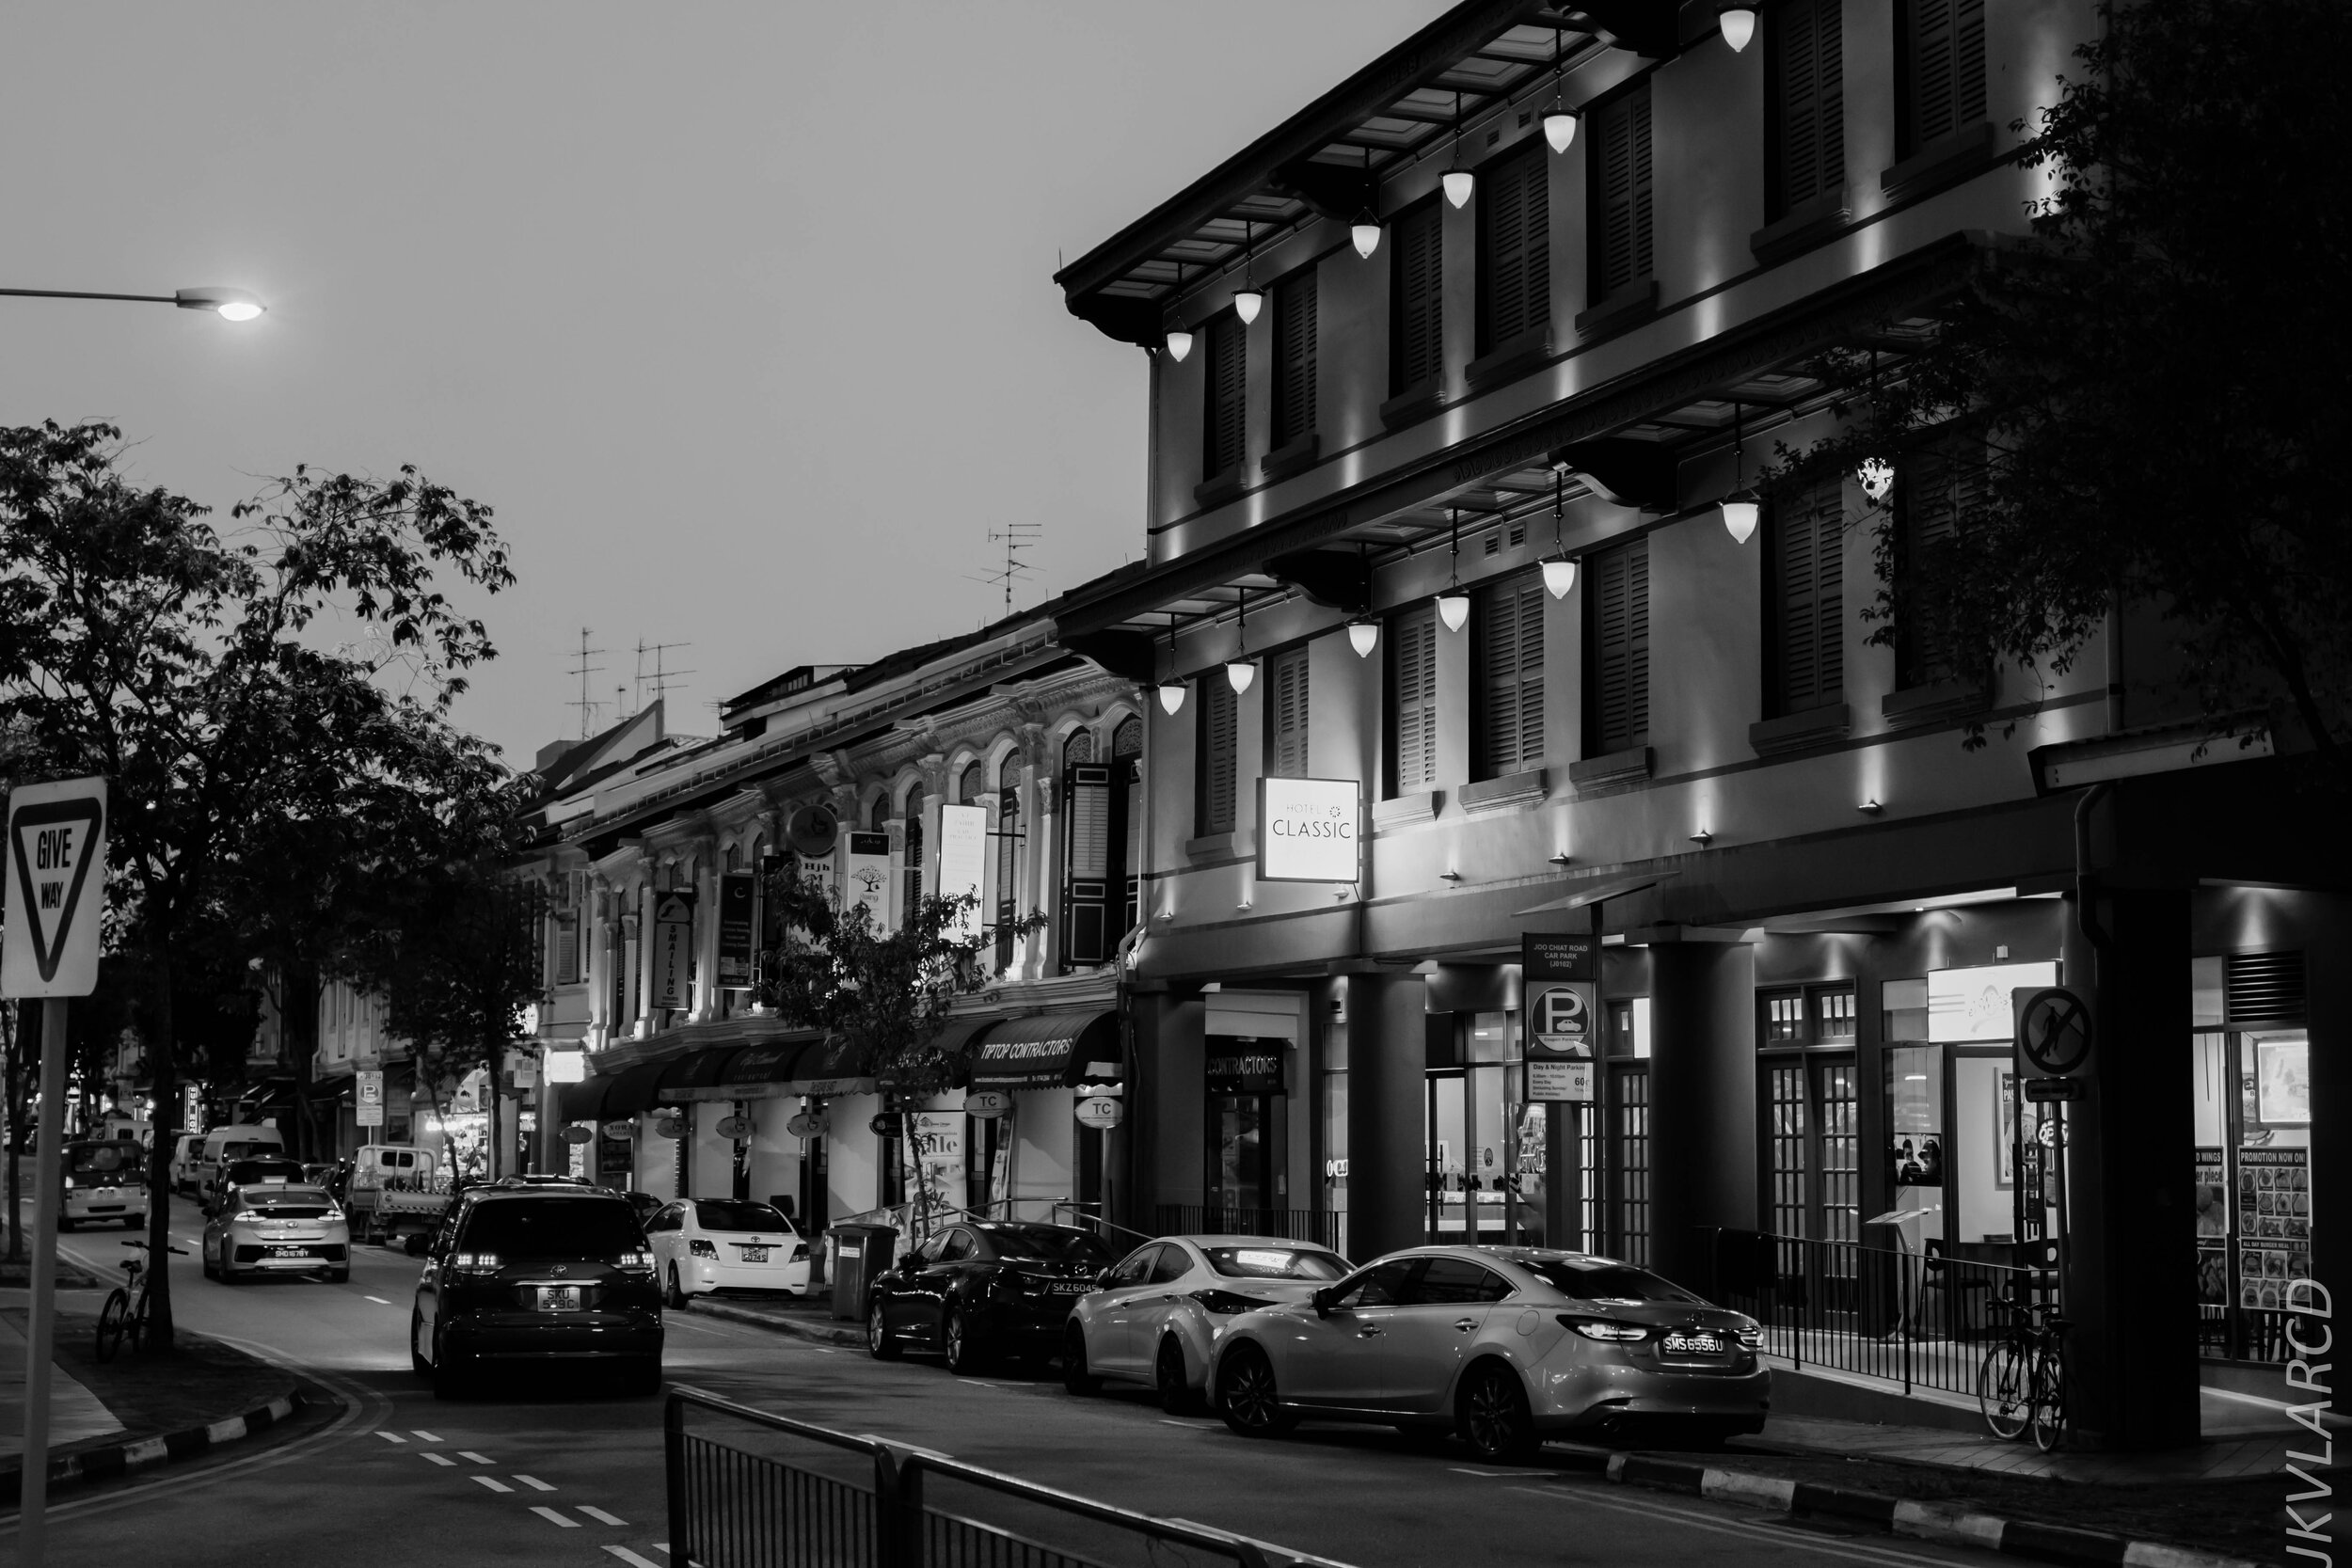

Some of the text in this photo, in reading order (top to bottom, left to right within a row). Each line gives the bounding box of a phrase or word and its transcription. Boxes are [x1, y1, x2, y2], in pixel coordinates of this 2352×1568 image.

[1286, 803, 1323, 815] HOTEL
[1272, 818, 1351, 839] CLASSIC
[37, 828, 72, 870] GIVE
[804, 863, 830, 872] Hjh
[41, 881, 64, 910] WAY
[666, 925, 677, 995] SMAILING
[1545, 992, 1582, 1035] P
[981, 1037, 1073, 1059] TIPTOP CONTRACTORS
[1207, 1055, 1278, 1075] CONTRACTORS
[979, 1096, 997, 1107] TC
[1092, 1103, 1112, 1115] TC
[2201, 1152, 2221, 1163] WINGS
[2240, 1151, 2277, 1163] PROMOTION
[2278, 1152, 2293, 1163] NOW
[548, 1290, 569, 1300] SKU
[1665, 1337, 1724, 1352] SMS6556U
